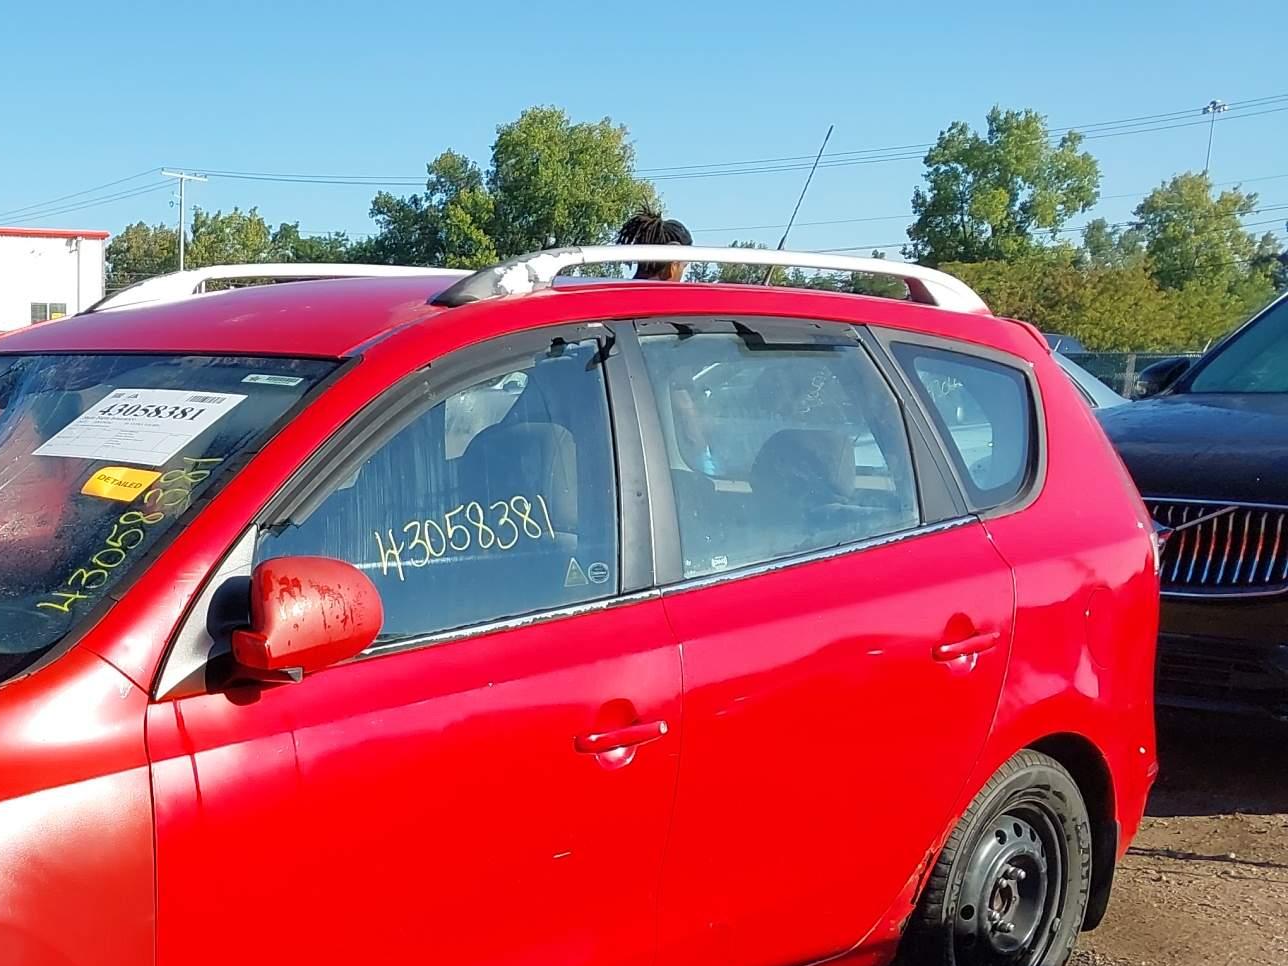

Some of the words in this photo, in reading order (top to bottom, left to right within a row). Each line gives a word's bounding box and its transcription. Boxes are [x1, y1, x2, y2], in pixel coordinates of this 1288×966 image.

[100, 403, 206, 422] 43058381
[97, 474, 144, 490] DETAILED
[36, 457, 224, 613] 43058381
[374, 494, 555, 580] 43058381
